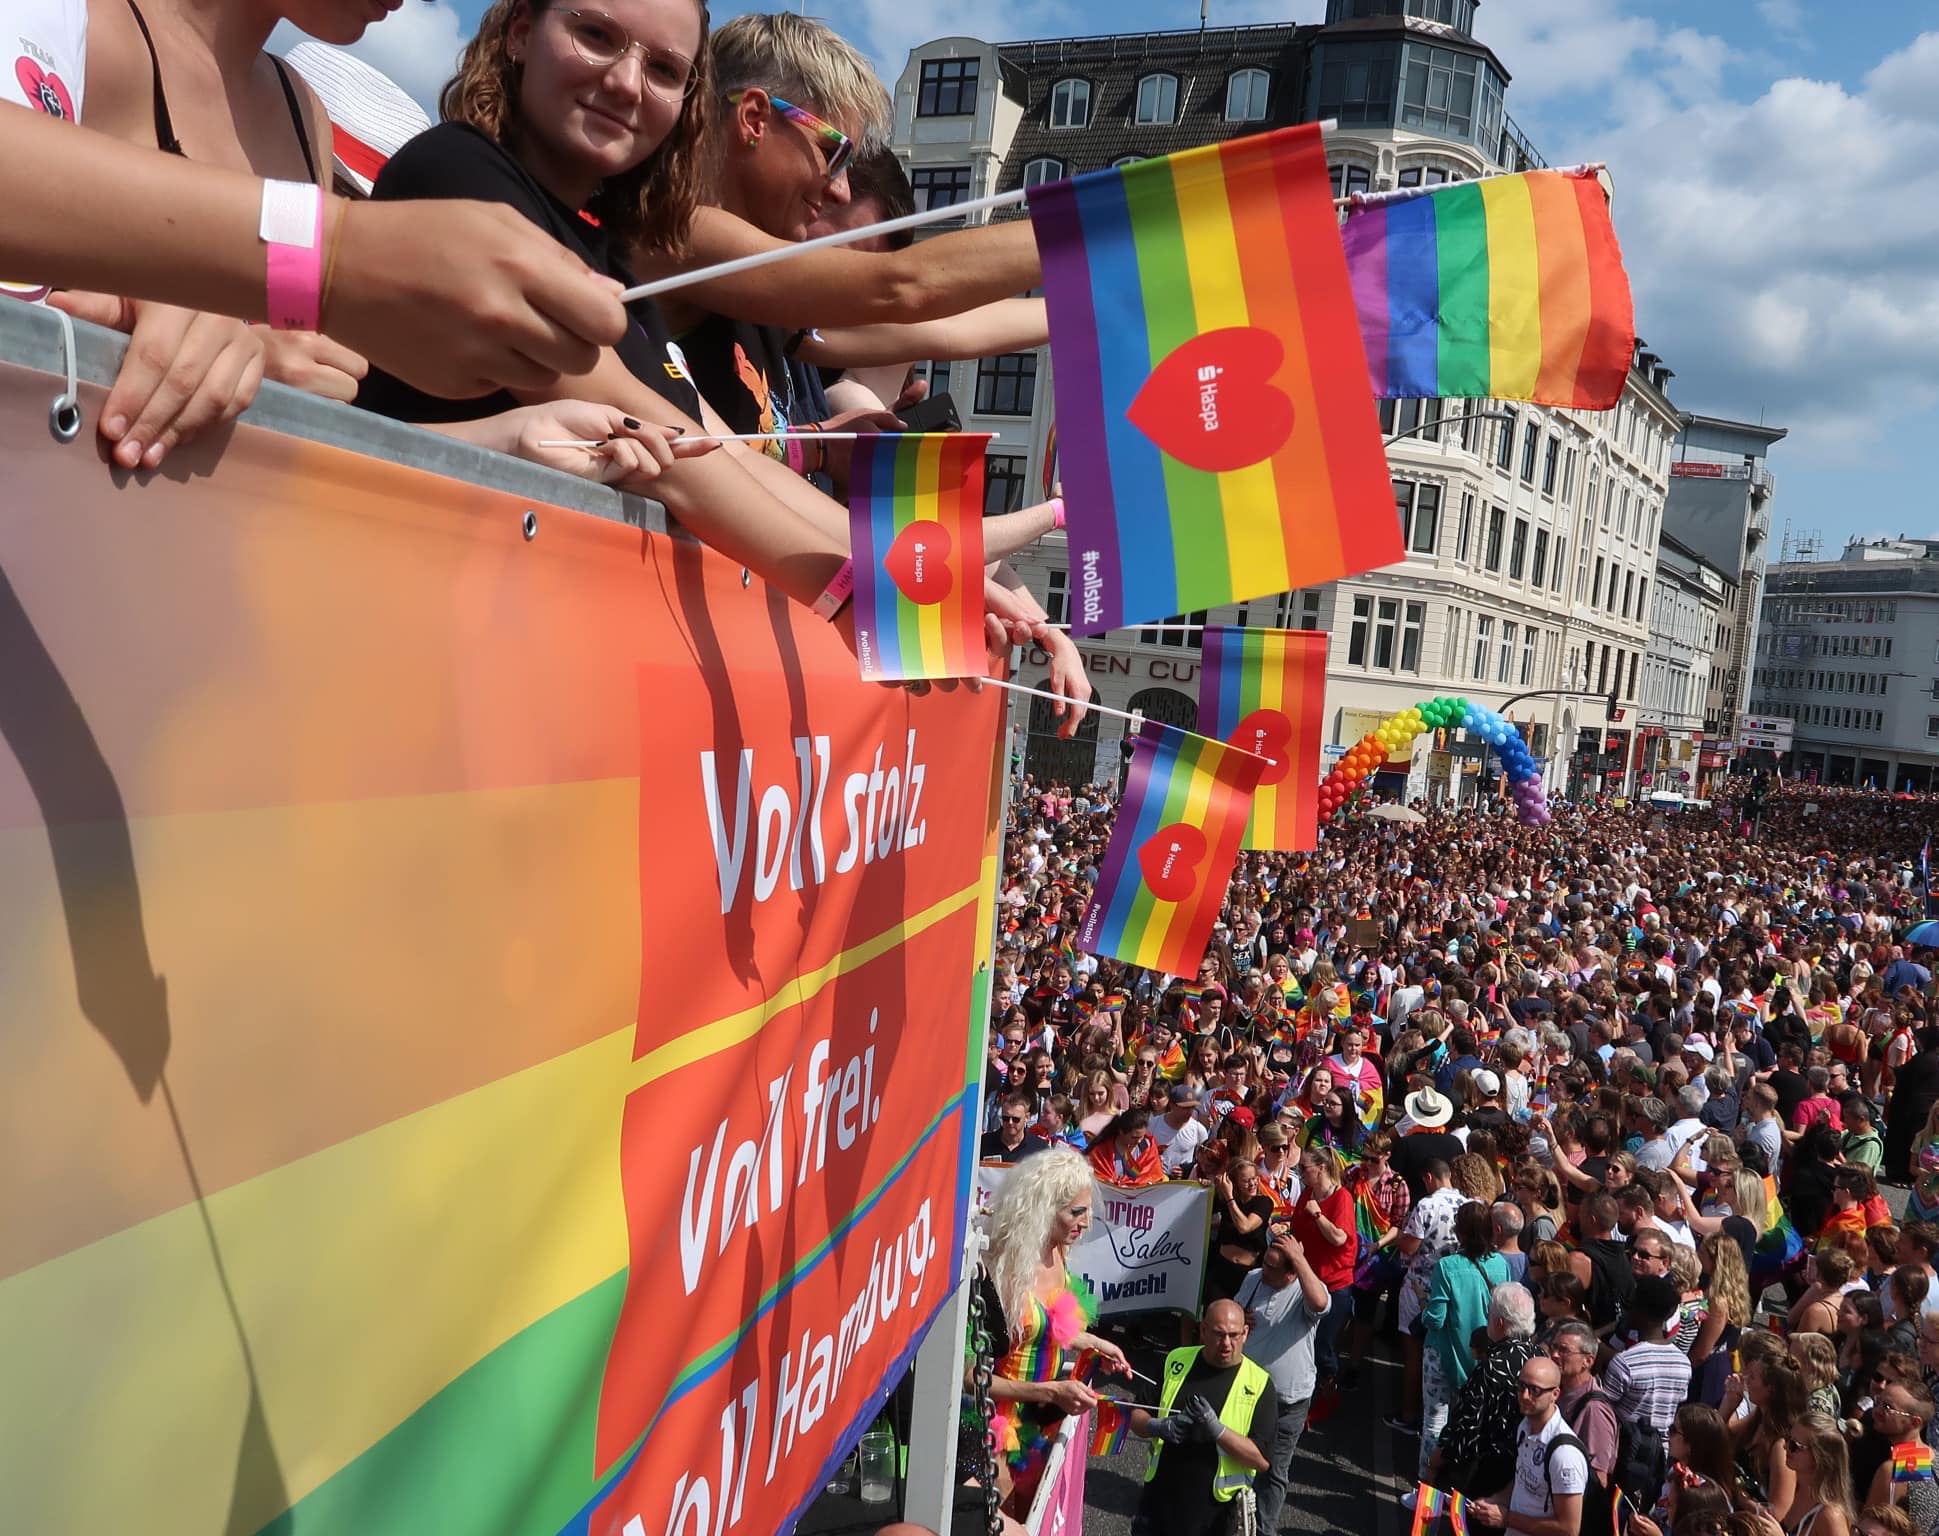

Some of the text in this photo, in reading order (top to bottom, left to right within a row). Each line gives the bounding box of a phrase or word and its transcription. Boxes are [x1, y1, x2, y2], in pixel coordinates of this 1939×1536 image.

[1199, 383, 1219, 431] Haspa
[915, 555, 924, 583] Haspa
[1082, 550, 1104, 625] #vollstolz
[860, 630, 873, 673] #vollstolz
[700, 728, 926, 914] Voll stolz.
[1161, 853, 1176, 879] Haspa
[1083, 903, 1101, 943] #vollstolz
[797, 1006, 880, 1188] frei.
[1120, 1227, 1187, 1263] Salon
[1101, 1272, 1167, 1301] wach!
[763, 1196, 936, 1488] Hamburg.
